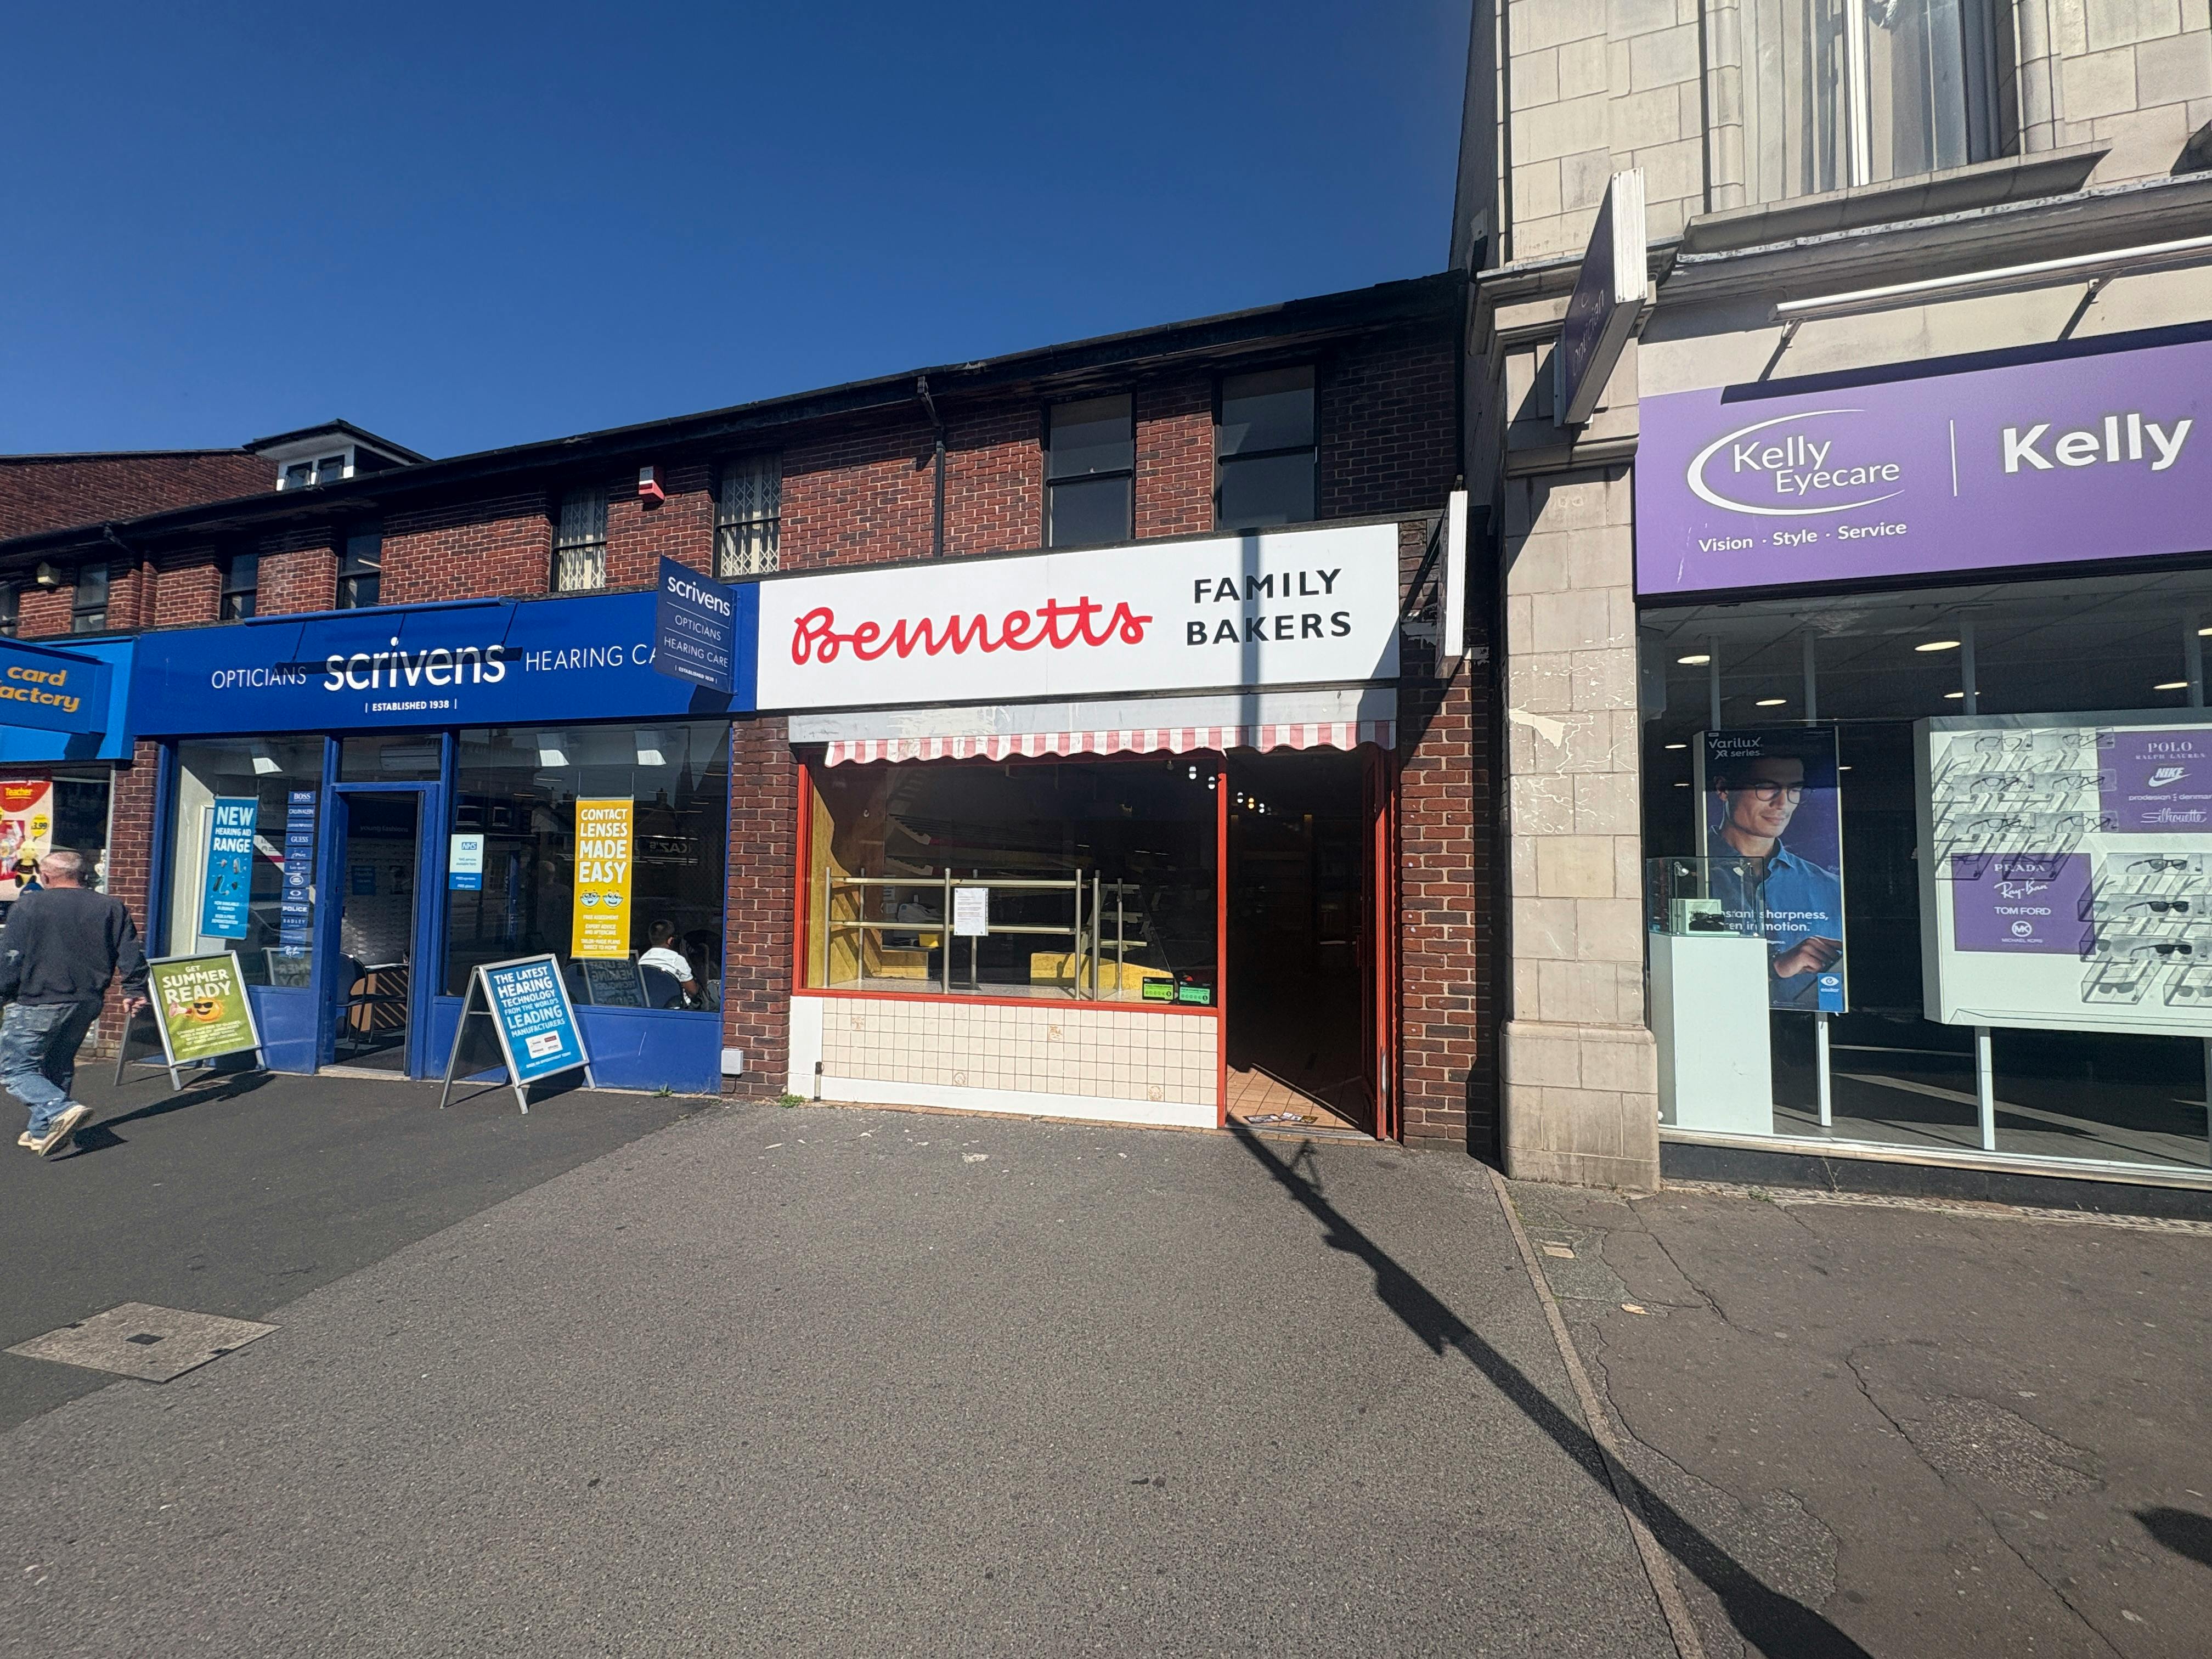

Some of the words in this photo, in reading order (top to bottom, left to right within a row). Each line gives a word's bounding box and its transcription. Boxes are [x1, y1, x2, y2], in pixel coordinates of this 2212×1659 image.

[2002, 413, 2193, 473] Kelly
[1734, 435, 1832, 472] Kelly
[1776, 462, 1900, 496] Eyecare
[1698, 537, 1753, 552] Vision
[1773, 529, 1818, 547] Style
[1838, 522, 1908, 540] Service
[1194, 568, 1342, 603] FAMILY
[667, 576, 731, 617] scrivens
[675, 614, 721, 641] OPTICIANS
[791, 595, 1153, 665] Bennetts
[1186, 611, 1351, 646] BAKERS
[526, 646, 623, 672] HEARING
[664, 636, 704, 659] HEARING
[707, 652, 729, 668] CARE
[323, 636, 506, 691] scrivens
[7, 666, 67, 686] card
[211, 666, 307, 689] OPTICIANS
[0, 680, 80, 713] actory
[372, 701, 427, 712] ESTABLISHED
[429, 700, 450, 709] 1938
[1708, 737, 1762, 749] Varilux
[1730, 749, 1761, 757] series
[2148, 741, 2192, 753] POLO
[2154, 767, 2185, 778] NIKE
[5, 787, 33, 796] Teacher
[216, 806, 255, 826] NEW
[580, 808, 628, 821] CONTACT
[2140, 808, 2207, 823] Silhouette
[215, 827, 241, 836] HEARING
[580, 822, 628, 838] LENSES
[213, 837, 251, 853] RANGE
[579, 839, 627, 859] MADE
[578, 861, 627, 884] EASY
[1994, 864, 2046, 872] PRADA
[1994, 878, 2048, 900] Ray-Ban
[1759, 909, 1829, 921] sharpness,
[1994, 906, 2018, 915] TOM
[2020, 907, 2051, 915] FORD
[162, 968, 229, 989] SUMMER
[185, 964, 201, 973] GET
[493, 973, 515, 985] THE
[517, 966, 548, 980] LATEST
[164, 980, 232, 1005] READY
[497, 976, 554, 999] HEARING
[501, 989, 556, 1008] TECHNOLOGY
[504, 1006, 521, 1016] FROM
[522, 1003, 534, 1011] THE
[506, 1004, 563, 1030] LEADING
[511, 1018, 566, 1038] MANUFACTURERS
